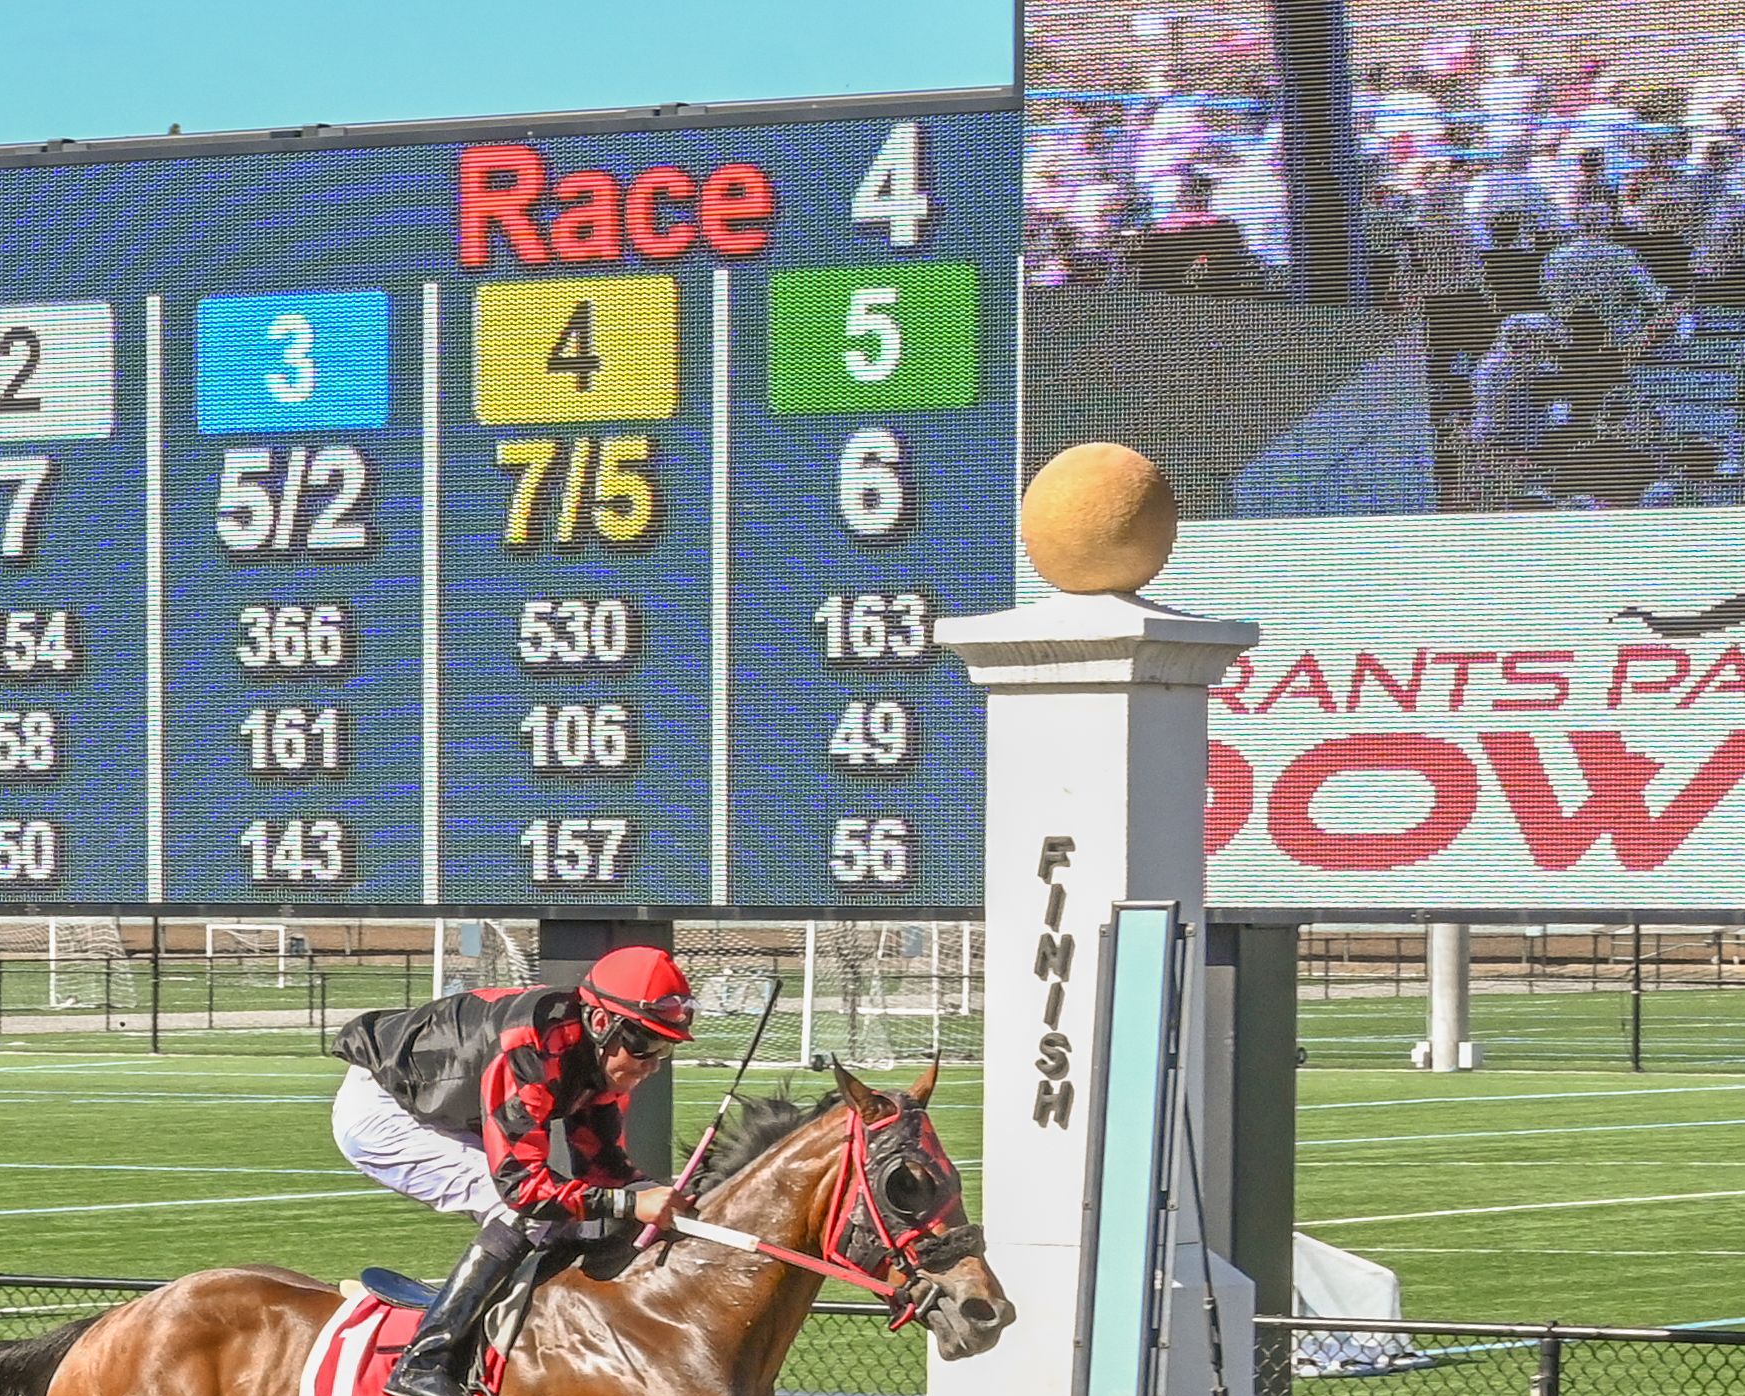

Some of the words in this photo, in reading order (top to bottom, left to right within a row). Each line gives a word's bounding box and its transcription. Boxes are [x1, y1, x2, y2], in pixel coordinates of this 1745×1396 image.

[460, 145, 772, 266] Race
[853, 123, 927, 244] 4
[0, 328, 39, 412] 2
[269, 315, 315, 402] 3
[548, 302, 598, 390] 4
[845, 287, 900, 381] 5
[217, 447, 365, 549] 5/2
[501, 436, 651, 542] 7/5
[840, 429, 901, 534] 6
[238, 606, 341, 666] 366
[519, 600, 626, 662] 530
[815, 594, 925, 657] 163
[241, 708, 336, 768] 161
[522, 705, 626, 766] 106
[830, 701, 906, 764] 49
[1204, 730, 1745, 872] OW
[241, 820, 341, 880] 143
[522, 819, 626, 880] 157
[830, 819, 905, 881] 56
[1033, 836, 1075, 1130] FINISH
